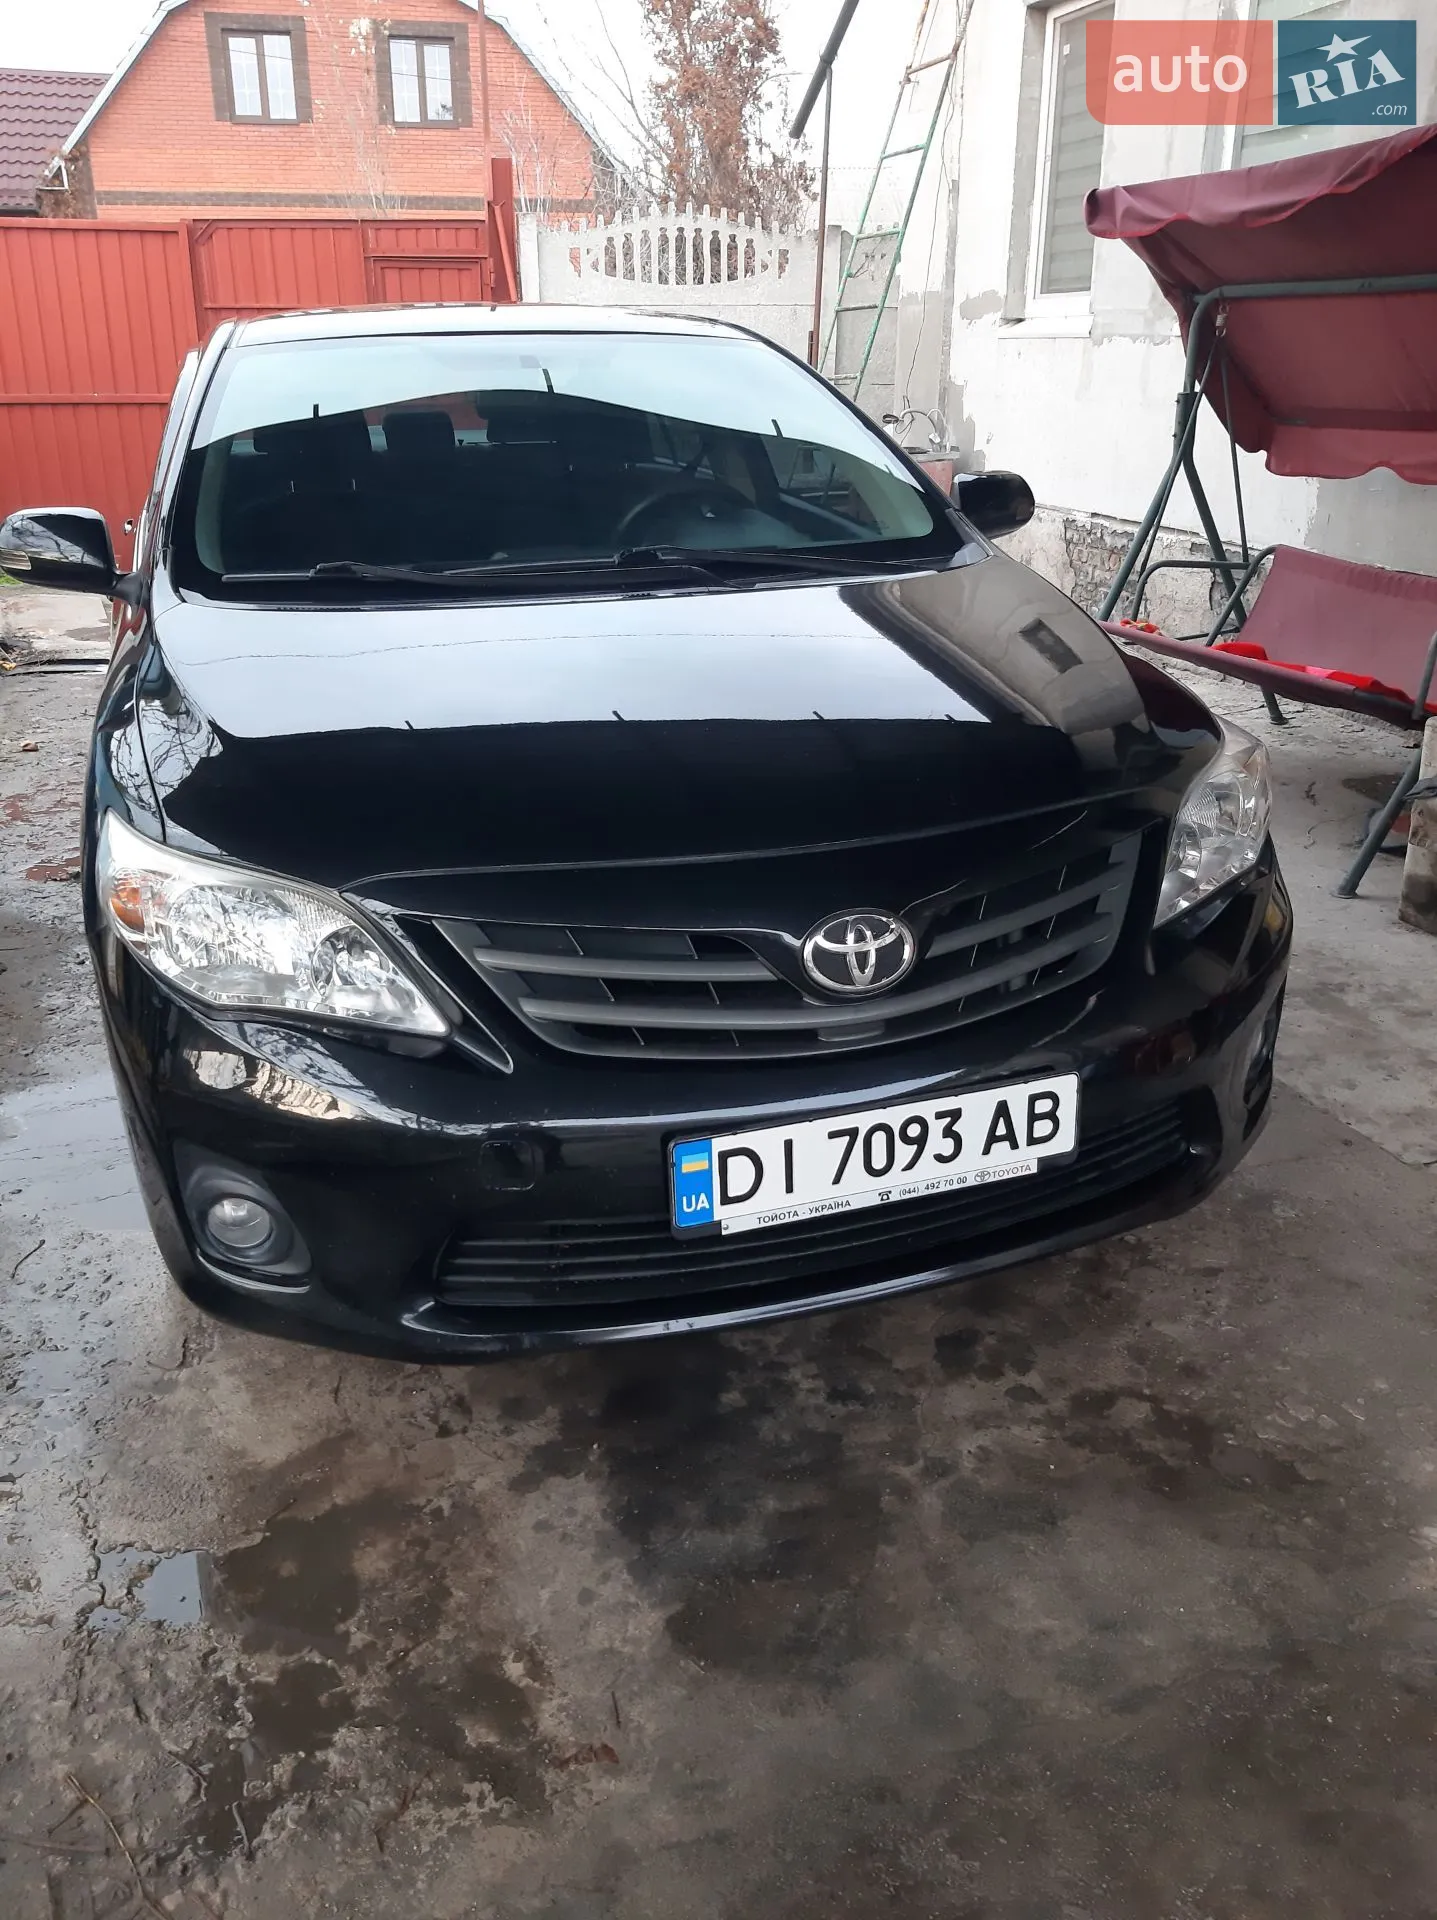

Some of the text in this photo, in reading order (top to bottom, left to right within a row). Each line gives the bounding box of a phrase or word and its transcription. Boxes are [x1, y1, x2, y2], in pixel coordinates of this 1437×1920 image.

[717, 1090, 1060, 1206] DI 7093 AB
[992, 1163, 1032, 1179] TOYOTA
[899, 1174, 968, 1198] (044) 492 70 00
[682, 1192, 710, 1213] UA
[757, 1209, 799, 1225] ТОЙОТА
[808, 1199, 851, 1215] УКРАЇНА
